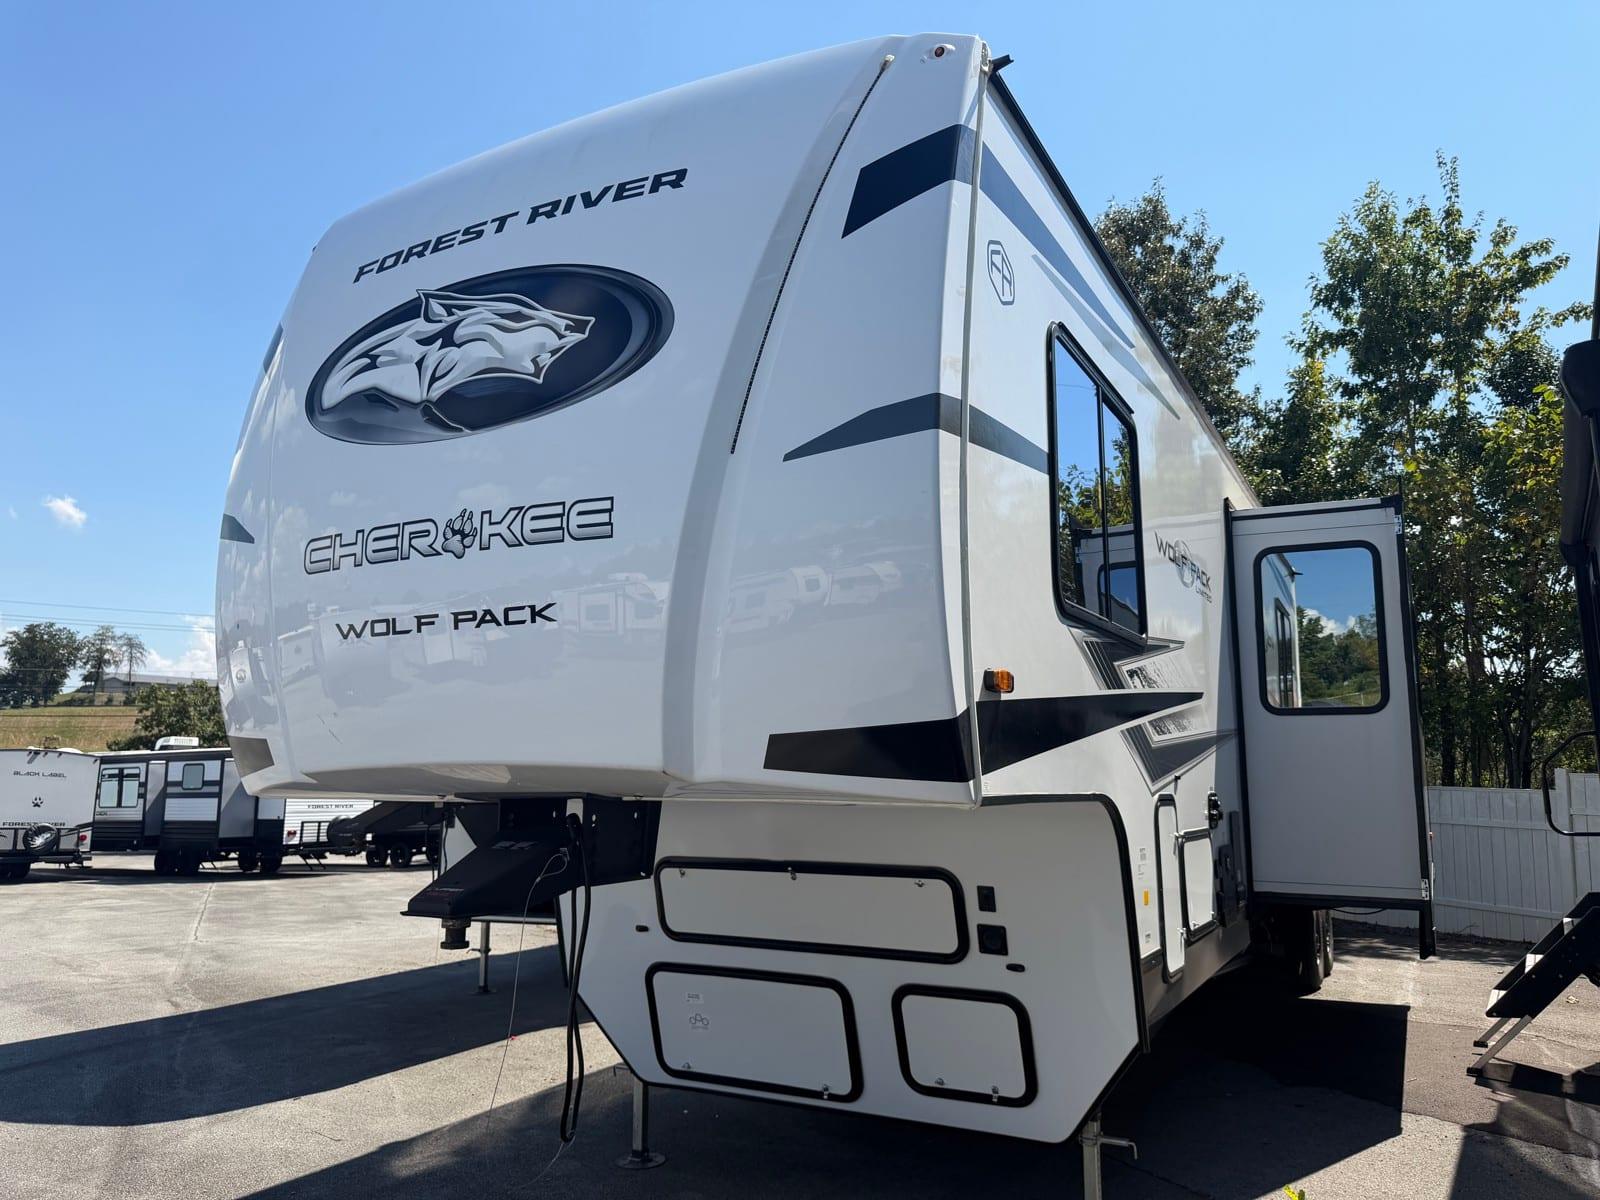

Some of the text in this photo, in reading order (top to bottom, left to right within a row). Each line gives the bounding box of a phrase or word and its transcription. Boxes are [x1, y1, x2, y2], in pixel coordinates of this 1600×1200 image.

[353, 168, 689, 284] FOREST RIVER
[304, 496, 614, 575] CHERKEE
[1154, 530, 1212, 592] WOLF PACK
[335, 602, 558, 640] WOLF PACK
